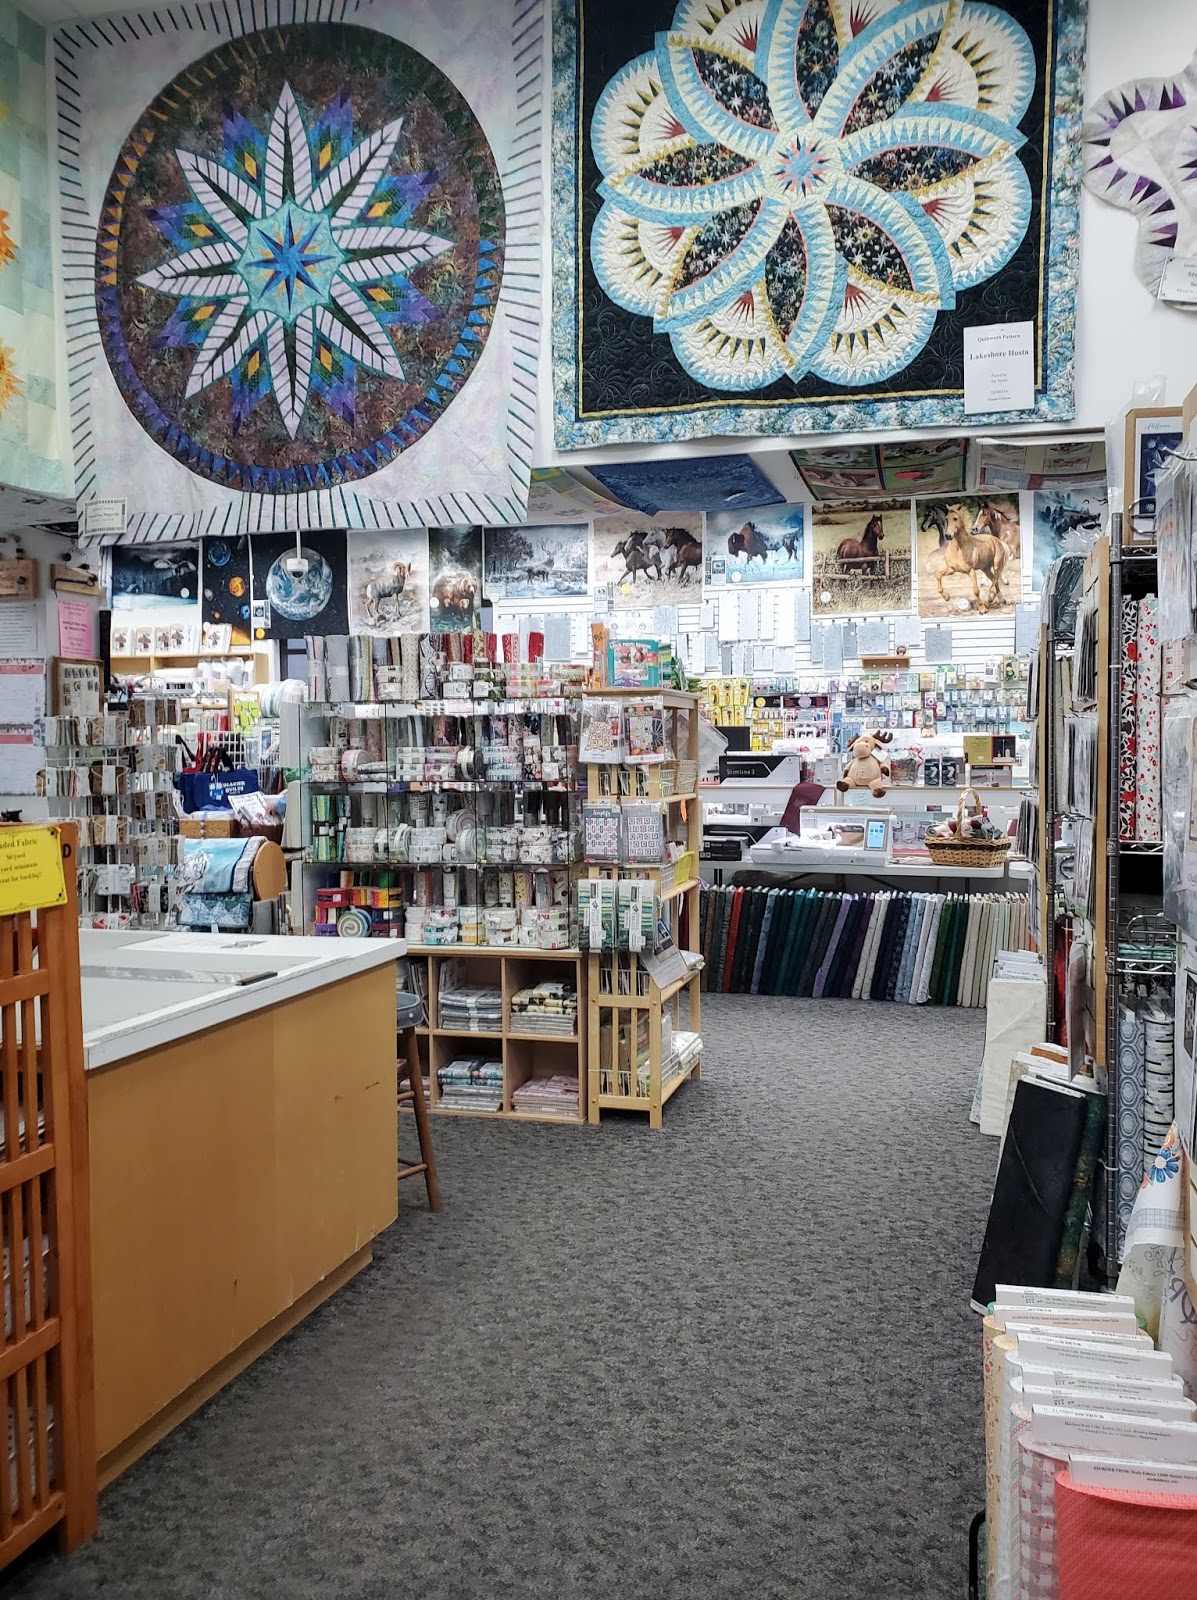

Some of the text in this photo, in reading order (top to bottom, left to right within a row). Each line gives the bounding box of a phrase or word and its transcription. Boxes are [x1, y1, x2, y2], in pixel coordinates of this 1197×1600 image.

[970, 349, 1029, 360] Lakeshore Hosta
[17, 838, 38, 847] Fabric
[62, 843, 72, 858] D
